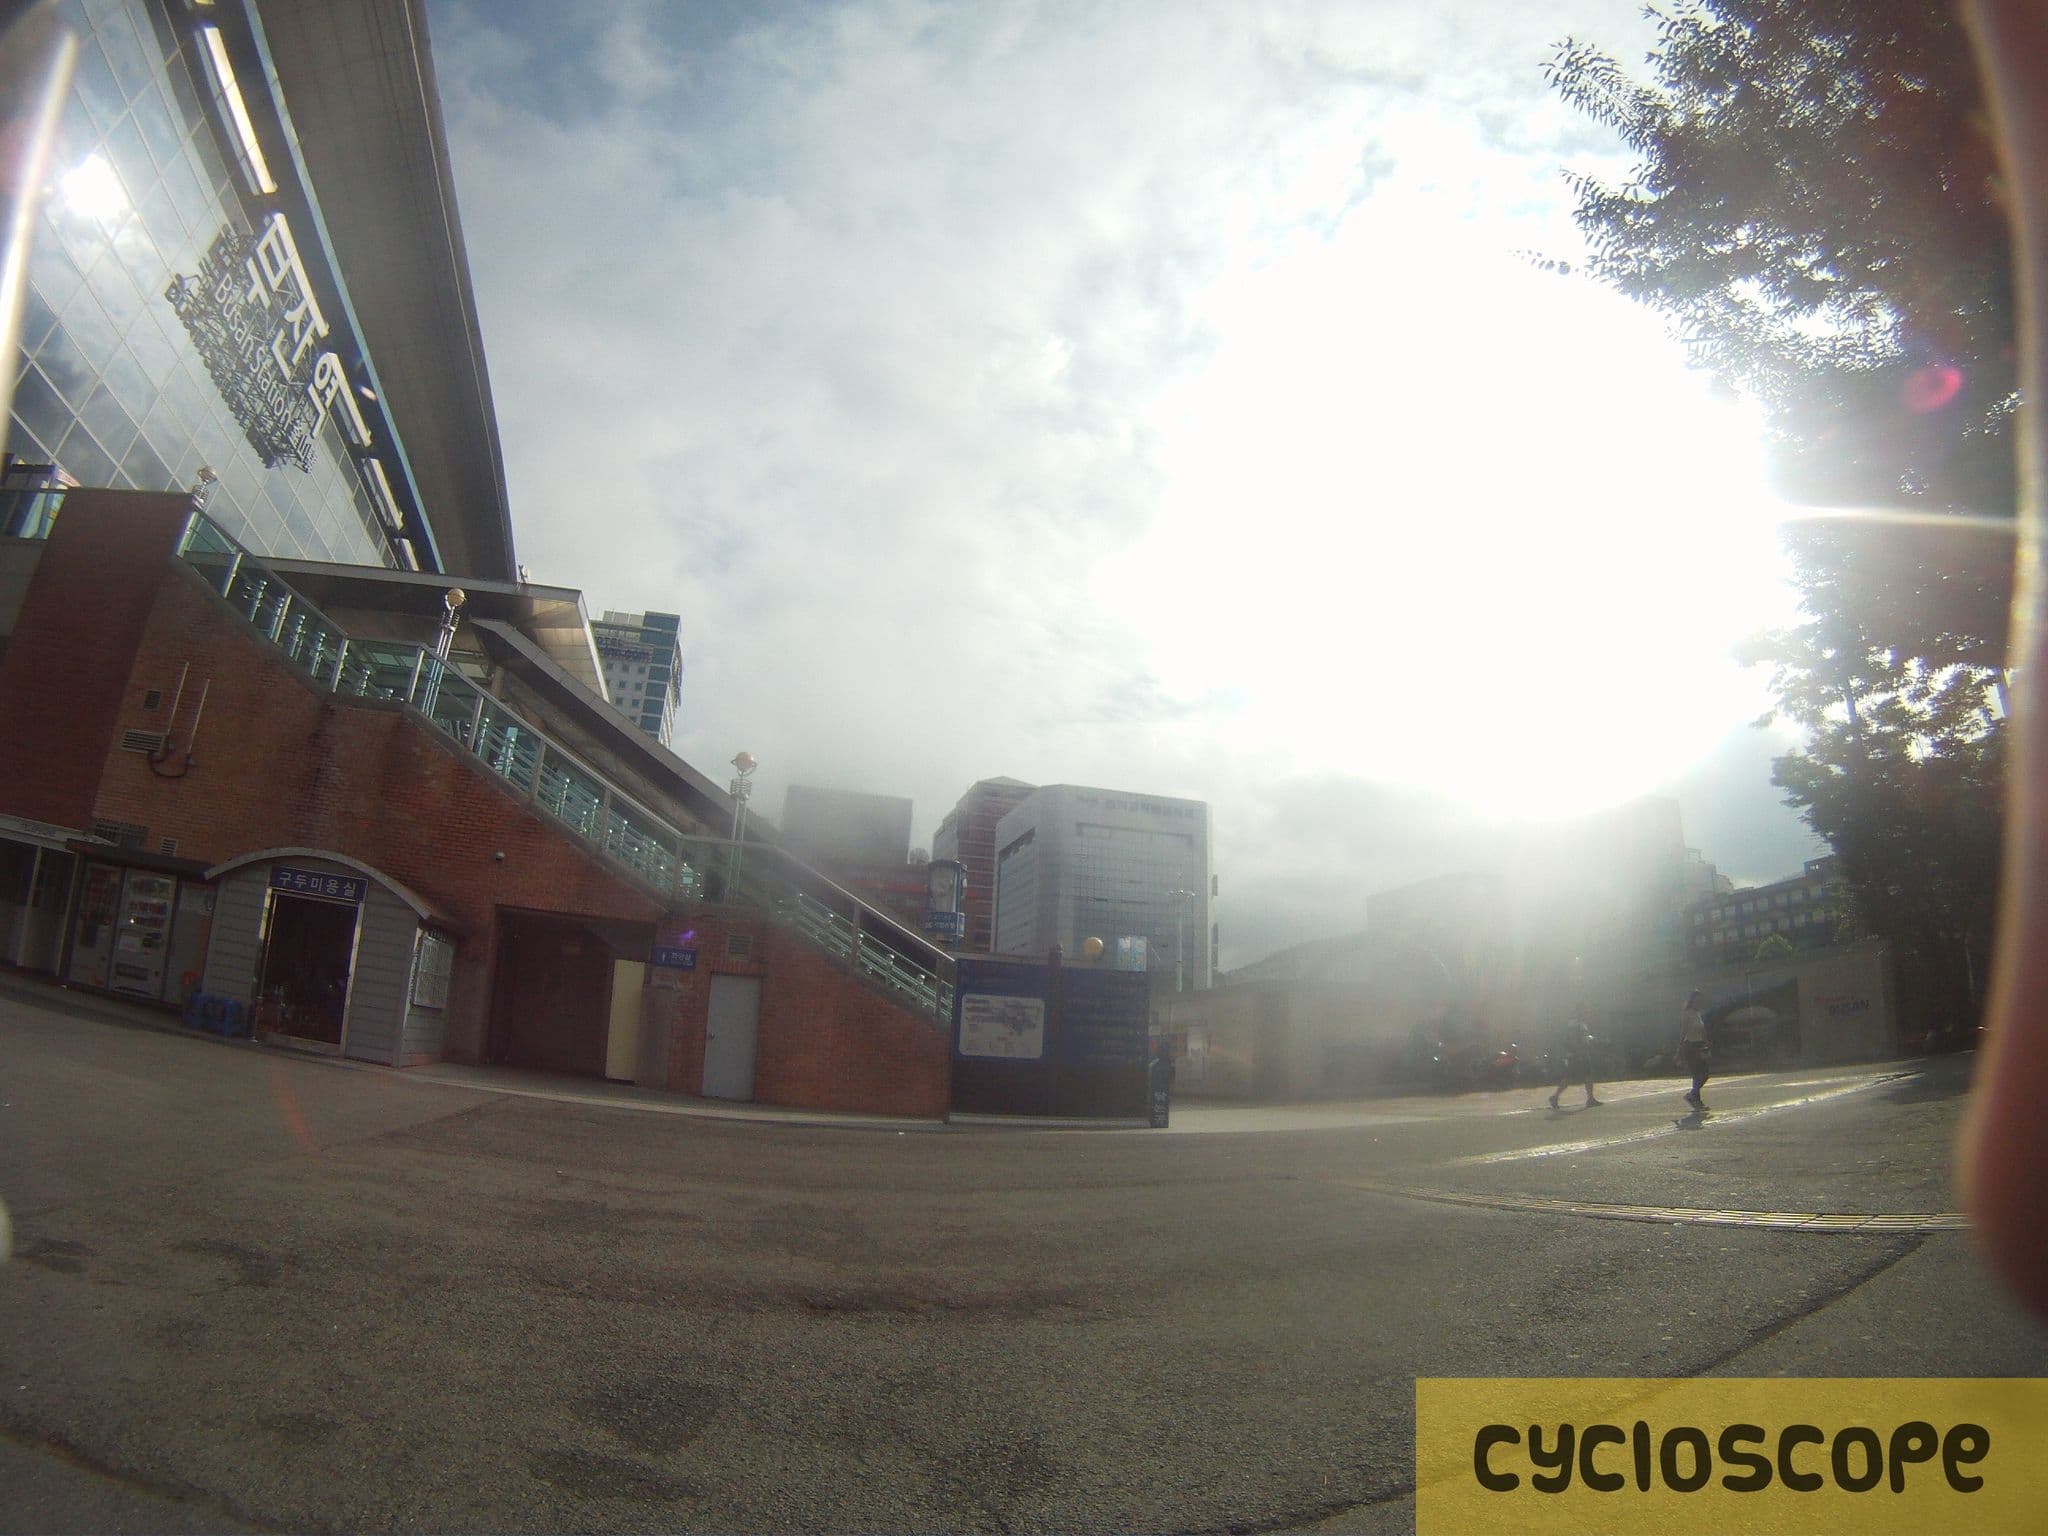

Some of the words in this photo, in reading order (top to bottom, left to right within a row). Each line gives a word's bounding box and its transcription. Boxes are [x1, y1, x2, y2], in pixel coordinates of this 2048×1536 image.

[214, 272, 257, 360] Busan
[250, 346, 294, 432] Station
[246, 219, 339, 439] 부산역
[279, 871, 357, 898] 구두미용실
